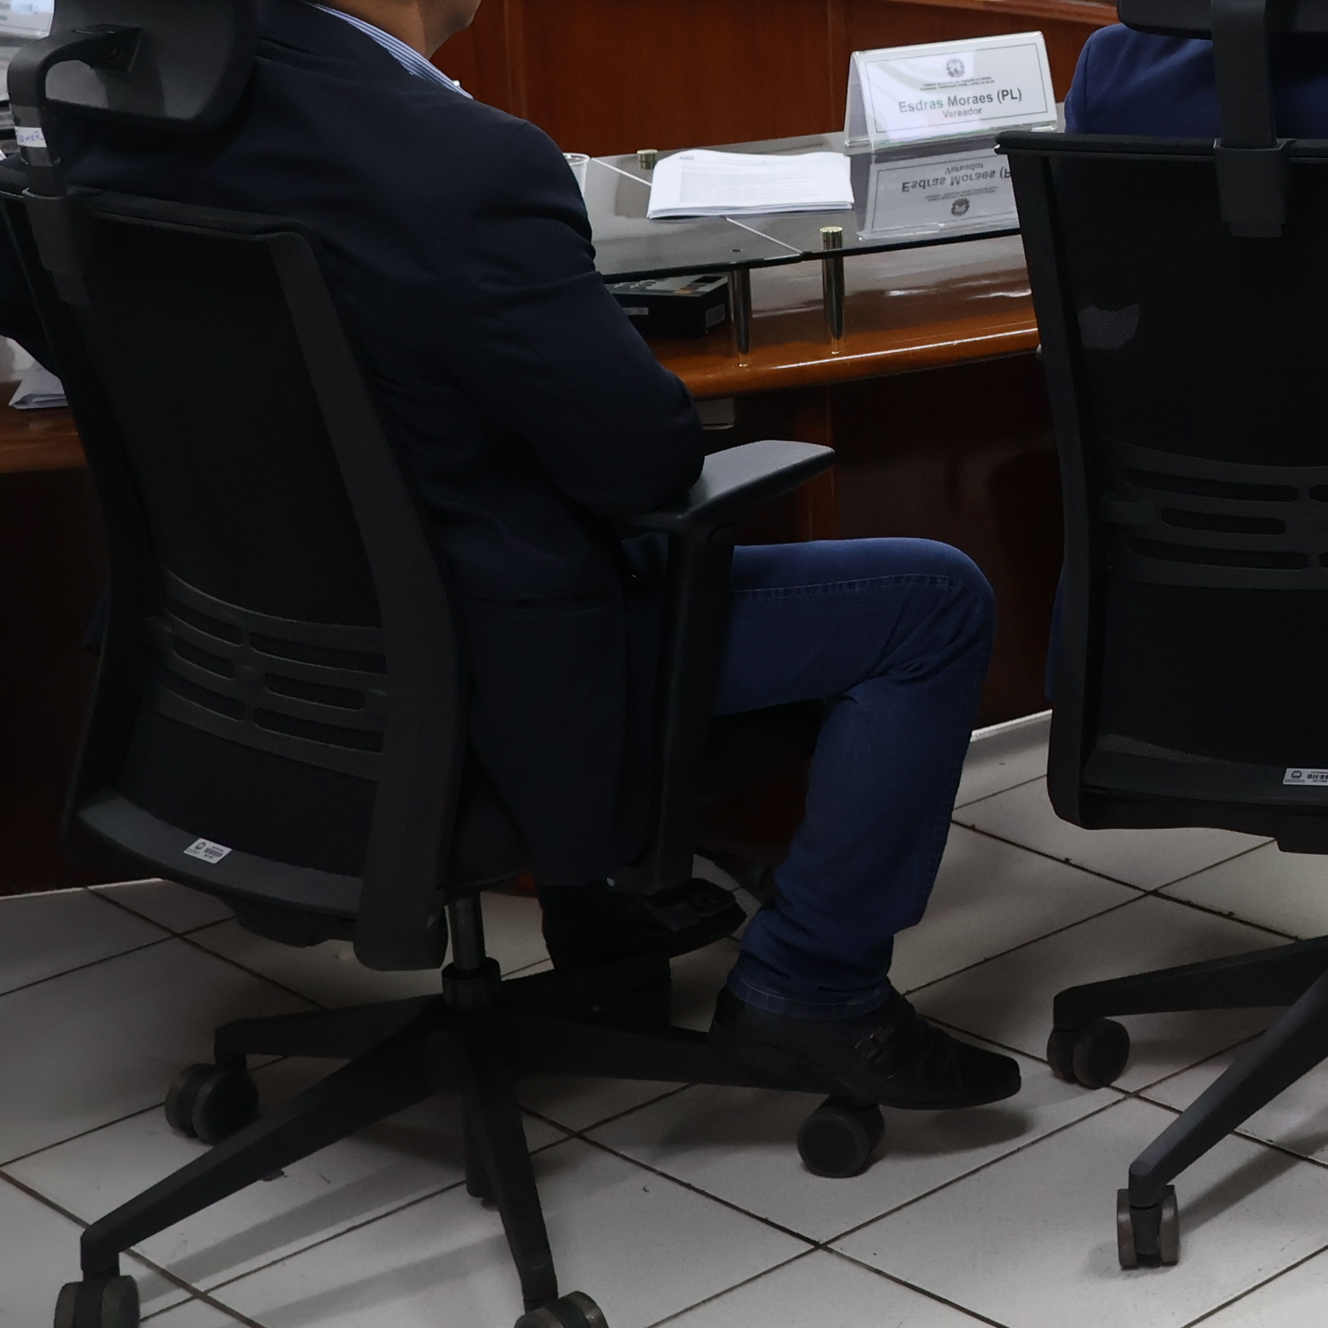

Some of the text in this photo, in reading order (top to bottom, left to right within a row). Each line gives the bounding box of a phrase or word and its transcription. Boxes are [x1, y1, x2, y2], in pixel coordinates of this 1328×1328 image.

[898, 86, 1023, 114] Esdras Moraes (PL)
[942, 106, 983, 119] Vereador
